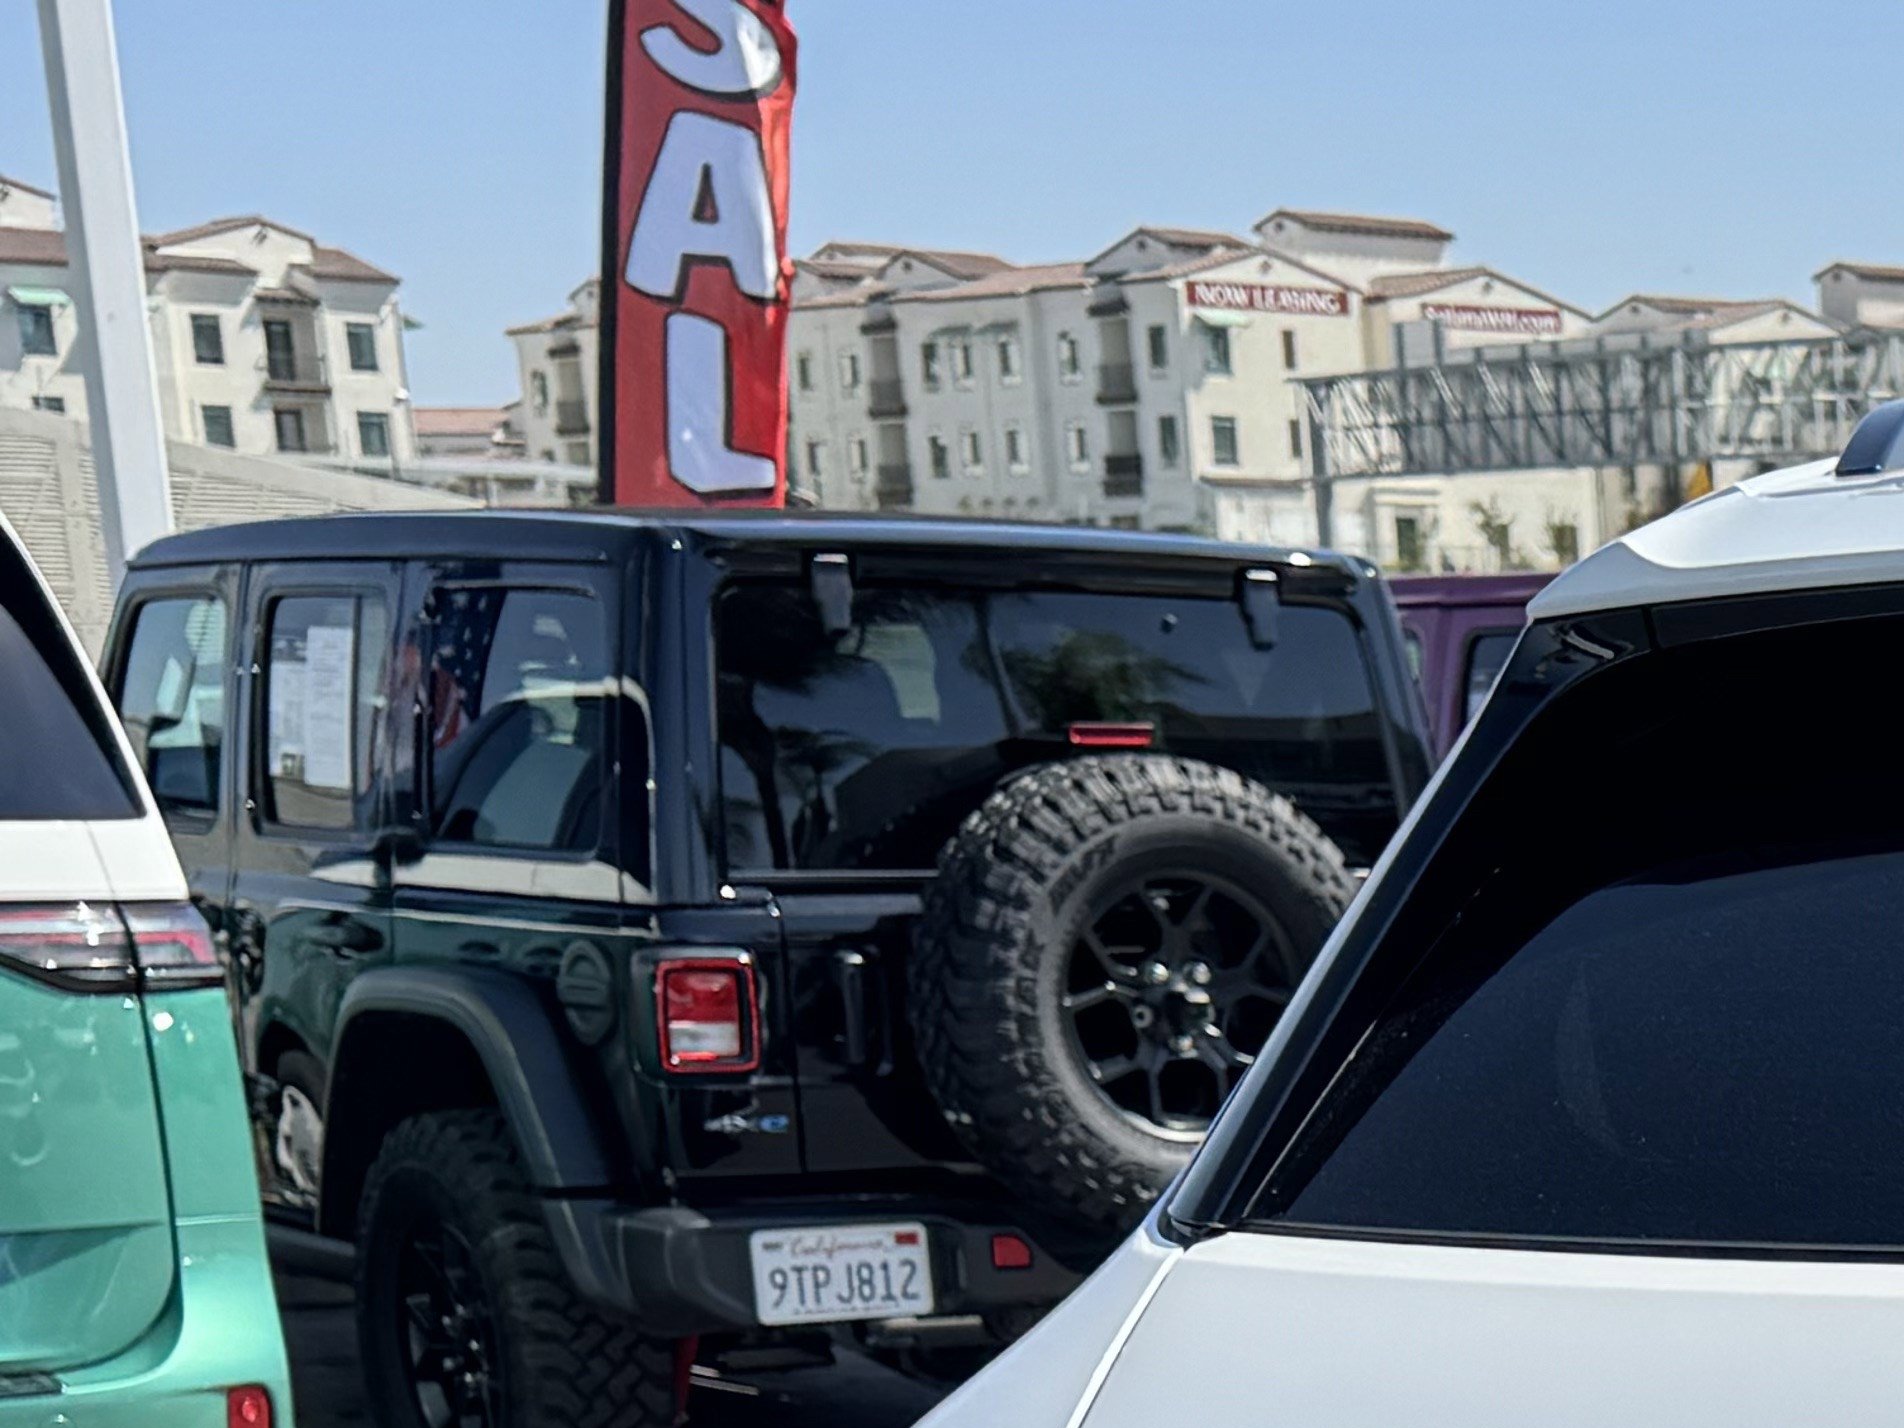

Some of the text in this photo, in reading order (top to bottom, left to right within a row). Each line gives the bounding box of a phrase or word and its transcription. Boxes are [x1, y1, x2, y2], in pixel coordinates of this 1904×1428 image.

[1195, 283, 1341, 316] NOW LEASING
[769, 1258, 921, 1308] 9TPJ812
